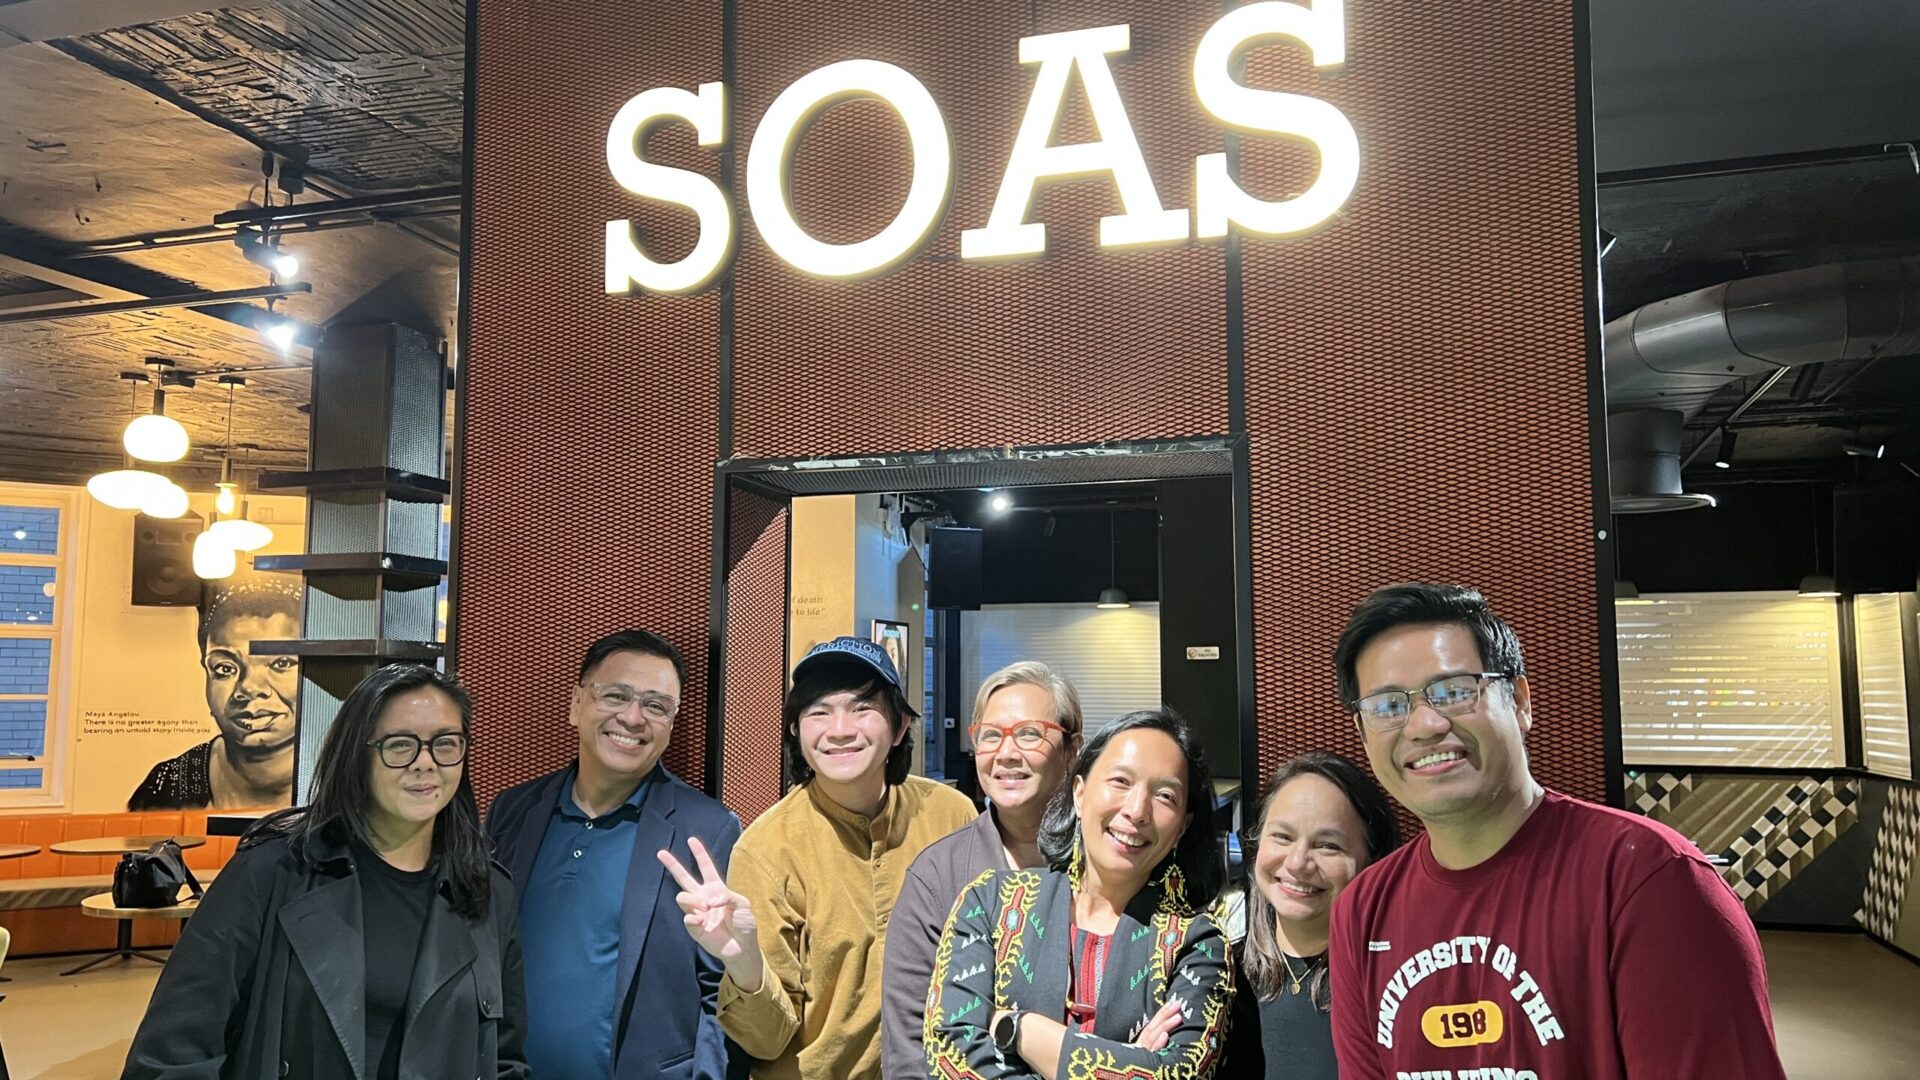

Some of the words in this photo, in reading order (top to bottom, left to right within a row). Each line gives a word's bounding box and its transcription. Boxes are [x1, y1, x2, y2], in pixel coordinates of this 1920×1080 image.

[605, 0, 1361, 294] SOAS
[84, 727, 113, 735] bearing
[1377, 935, 1491, 1049] UNIVERSITY
[1510, 970, 1565, 1047] THE
